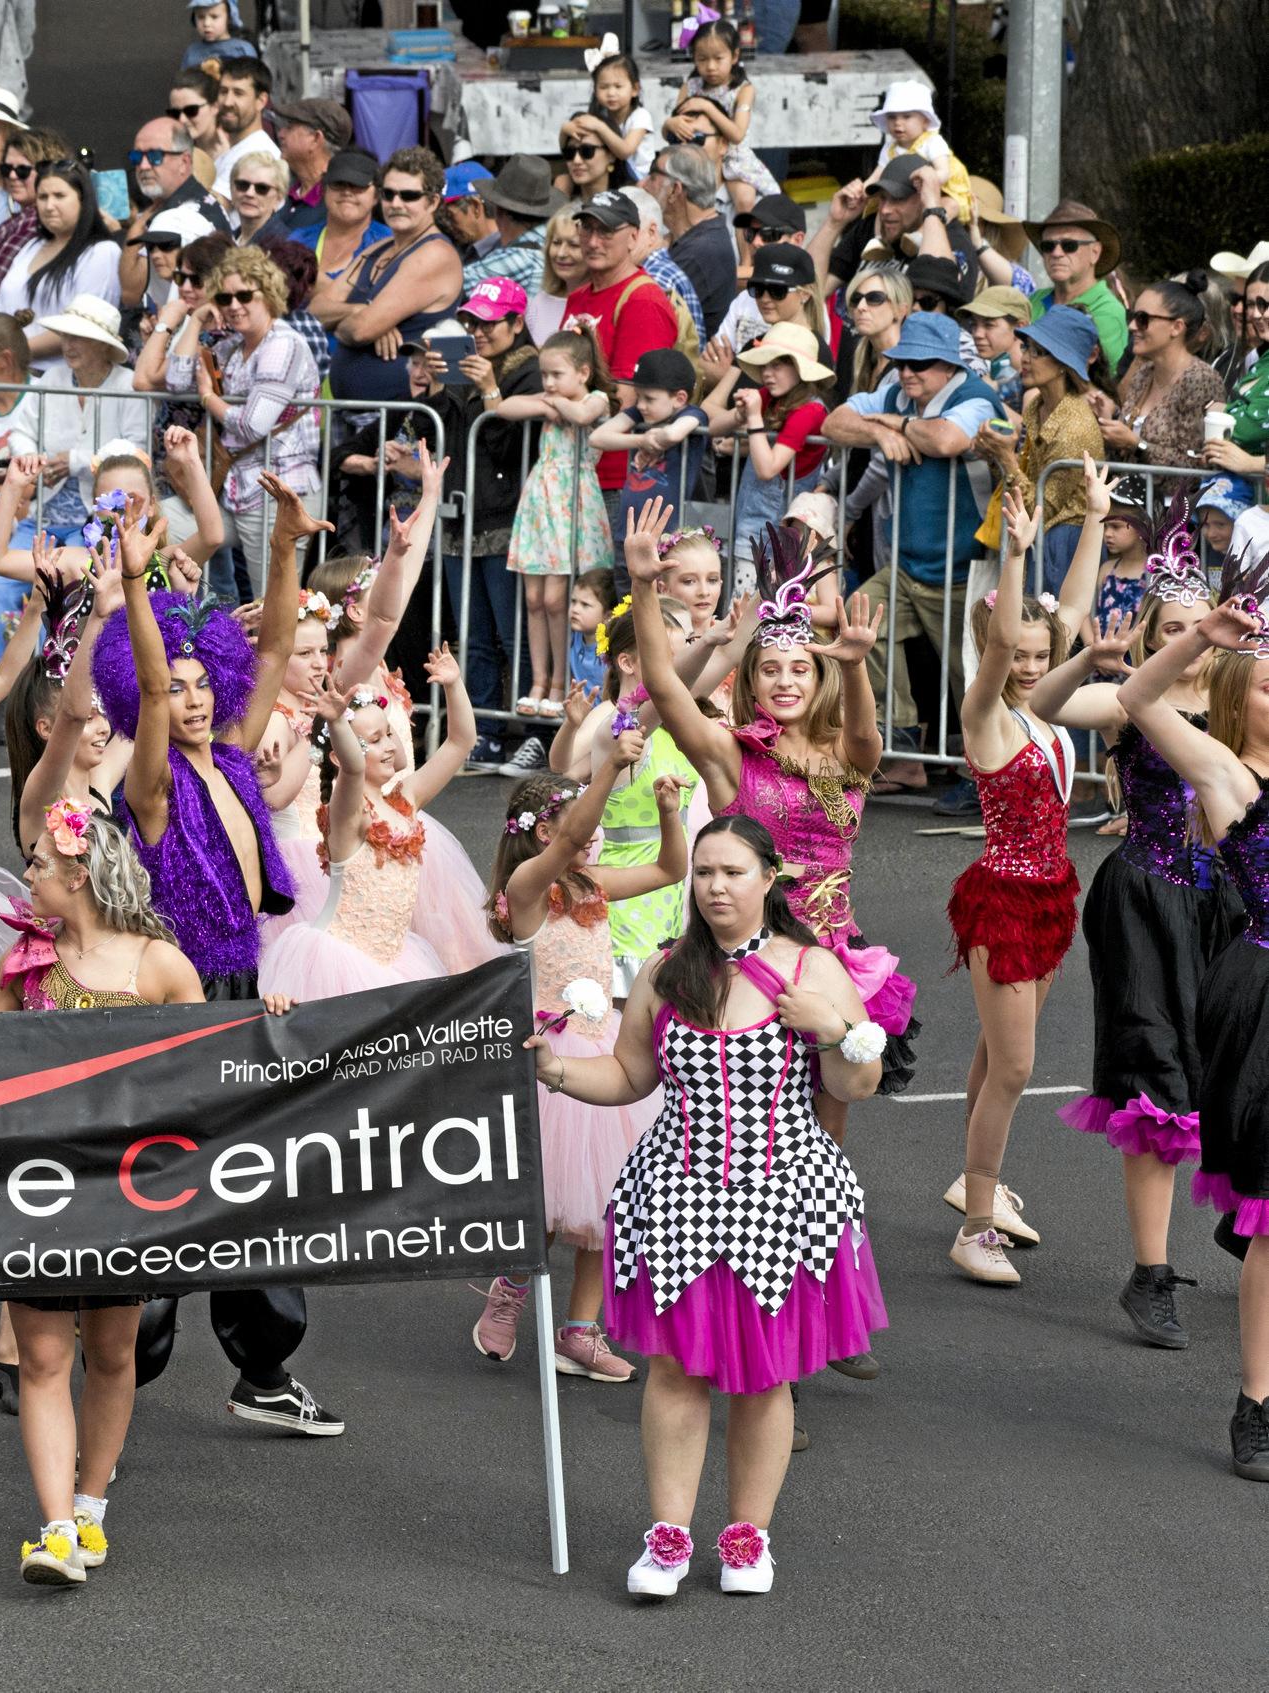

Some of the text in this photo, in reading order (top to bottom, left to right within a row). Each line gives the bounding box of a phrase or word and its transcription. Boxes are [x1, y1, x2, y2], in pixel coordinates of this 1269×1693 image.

[220, 1014, 514, 1083] Principal Alison Vallette
[332, 1042, 513, 1080] ARAD MSFD RAD RTS
[118, 1094, 519, 1211] Central
